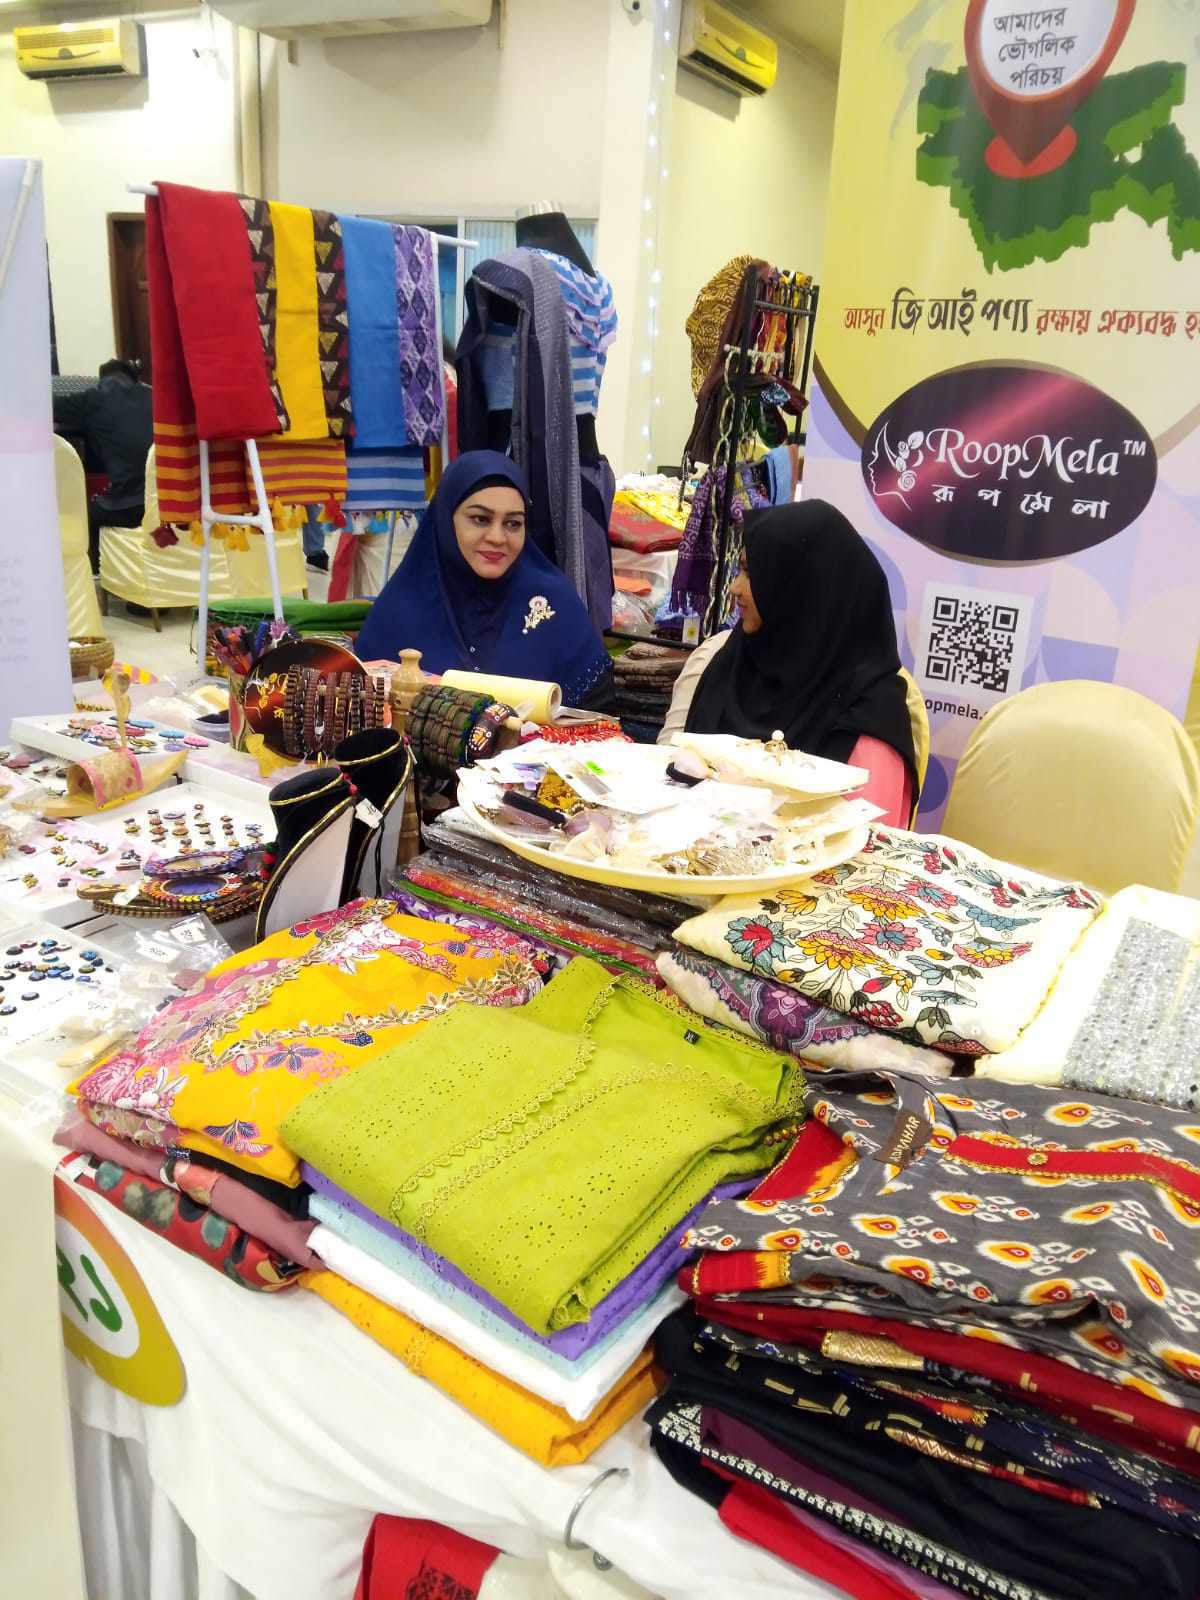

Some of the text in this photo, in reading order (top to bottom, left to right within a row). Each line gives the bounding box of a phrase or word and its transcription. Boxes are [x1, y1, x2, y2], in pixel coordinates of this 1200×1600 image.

[993, 8, 1068, 32] আমাদের
[998, 32, 1079, 62] ভৌগলিক
[1010, 63, 1067, 89] পরিচয়
[843, 307, 887, 337] আসুন
[980, 298, 1034, 334] পণ্য
[1036, 308, 1093, 336] রক্ষায়
[1184, 310, 1200, 341] হ
[924, 698, 988, 721] opmela.
